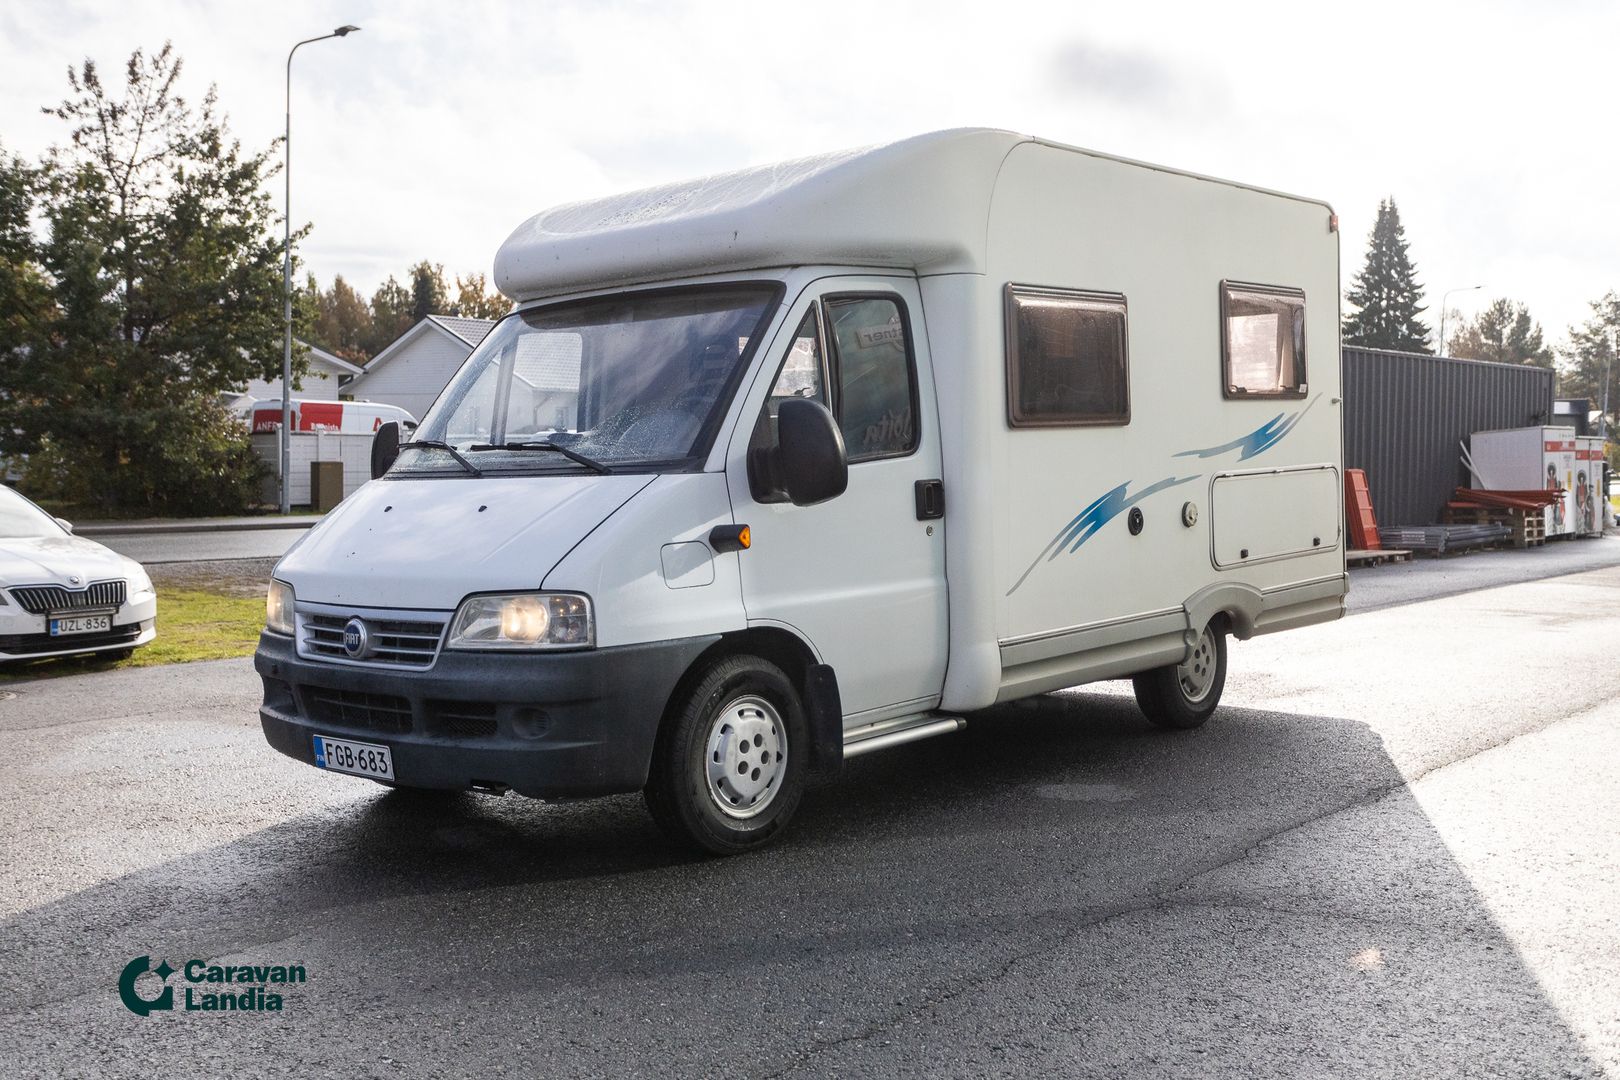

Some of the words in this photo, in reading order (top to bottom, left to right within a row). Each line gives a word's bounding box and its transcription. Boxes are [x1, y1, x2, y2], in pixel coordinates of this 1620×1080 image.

[60, 618, 107, 632] UZL-836
[345, 632, 360, 645] FIAT
[325, 743, 388, 774] FGB-683
